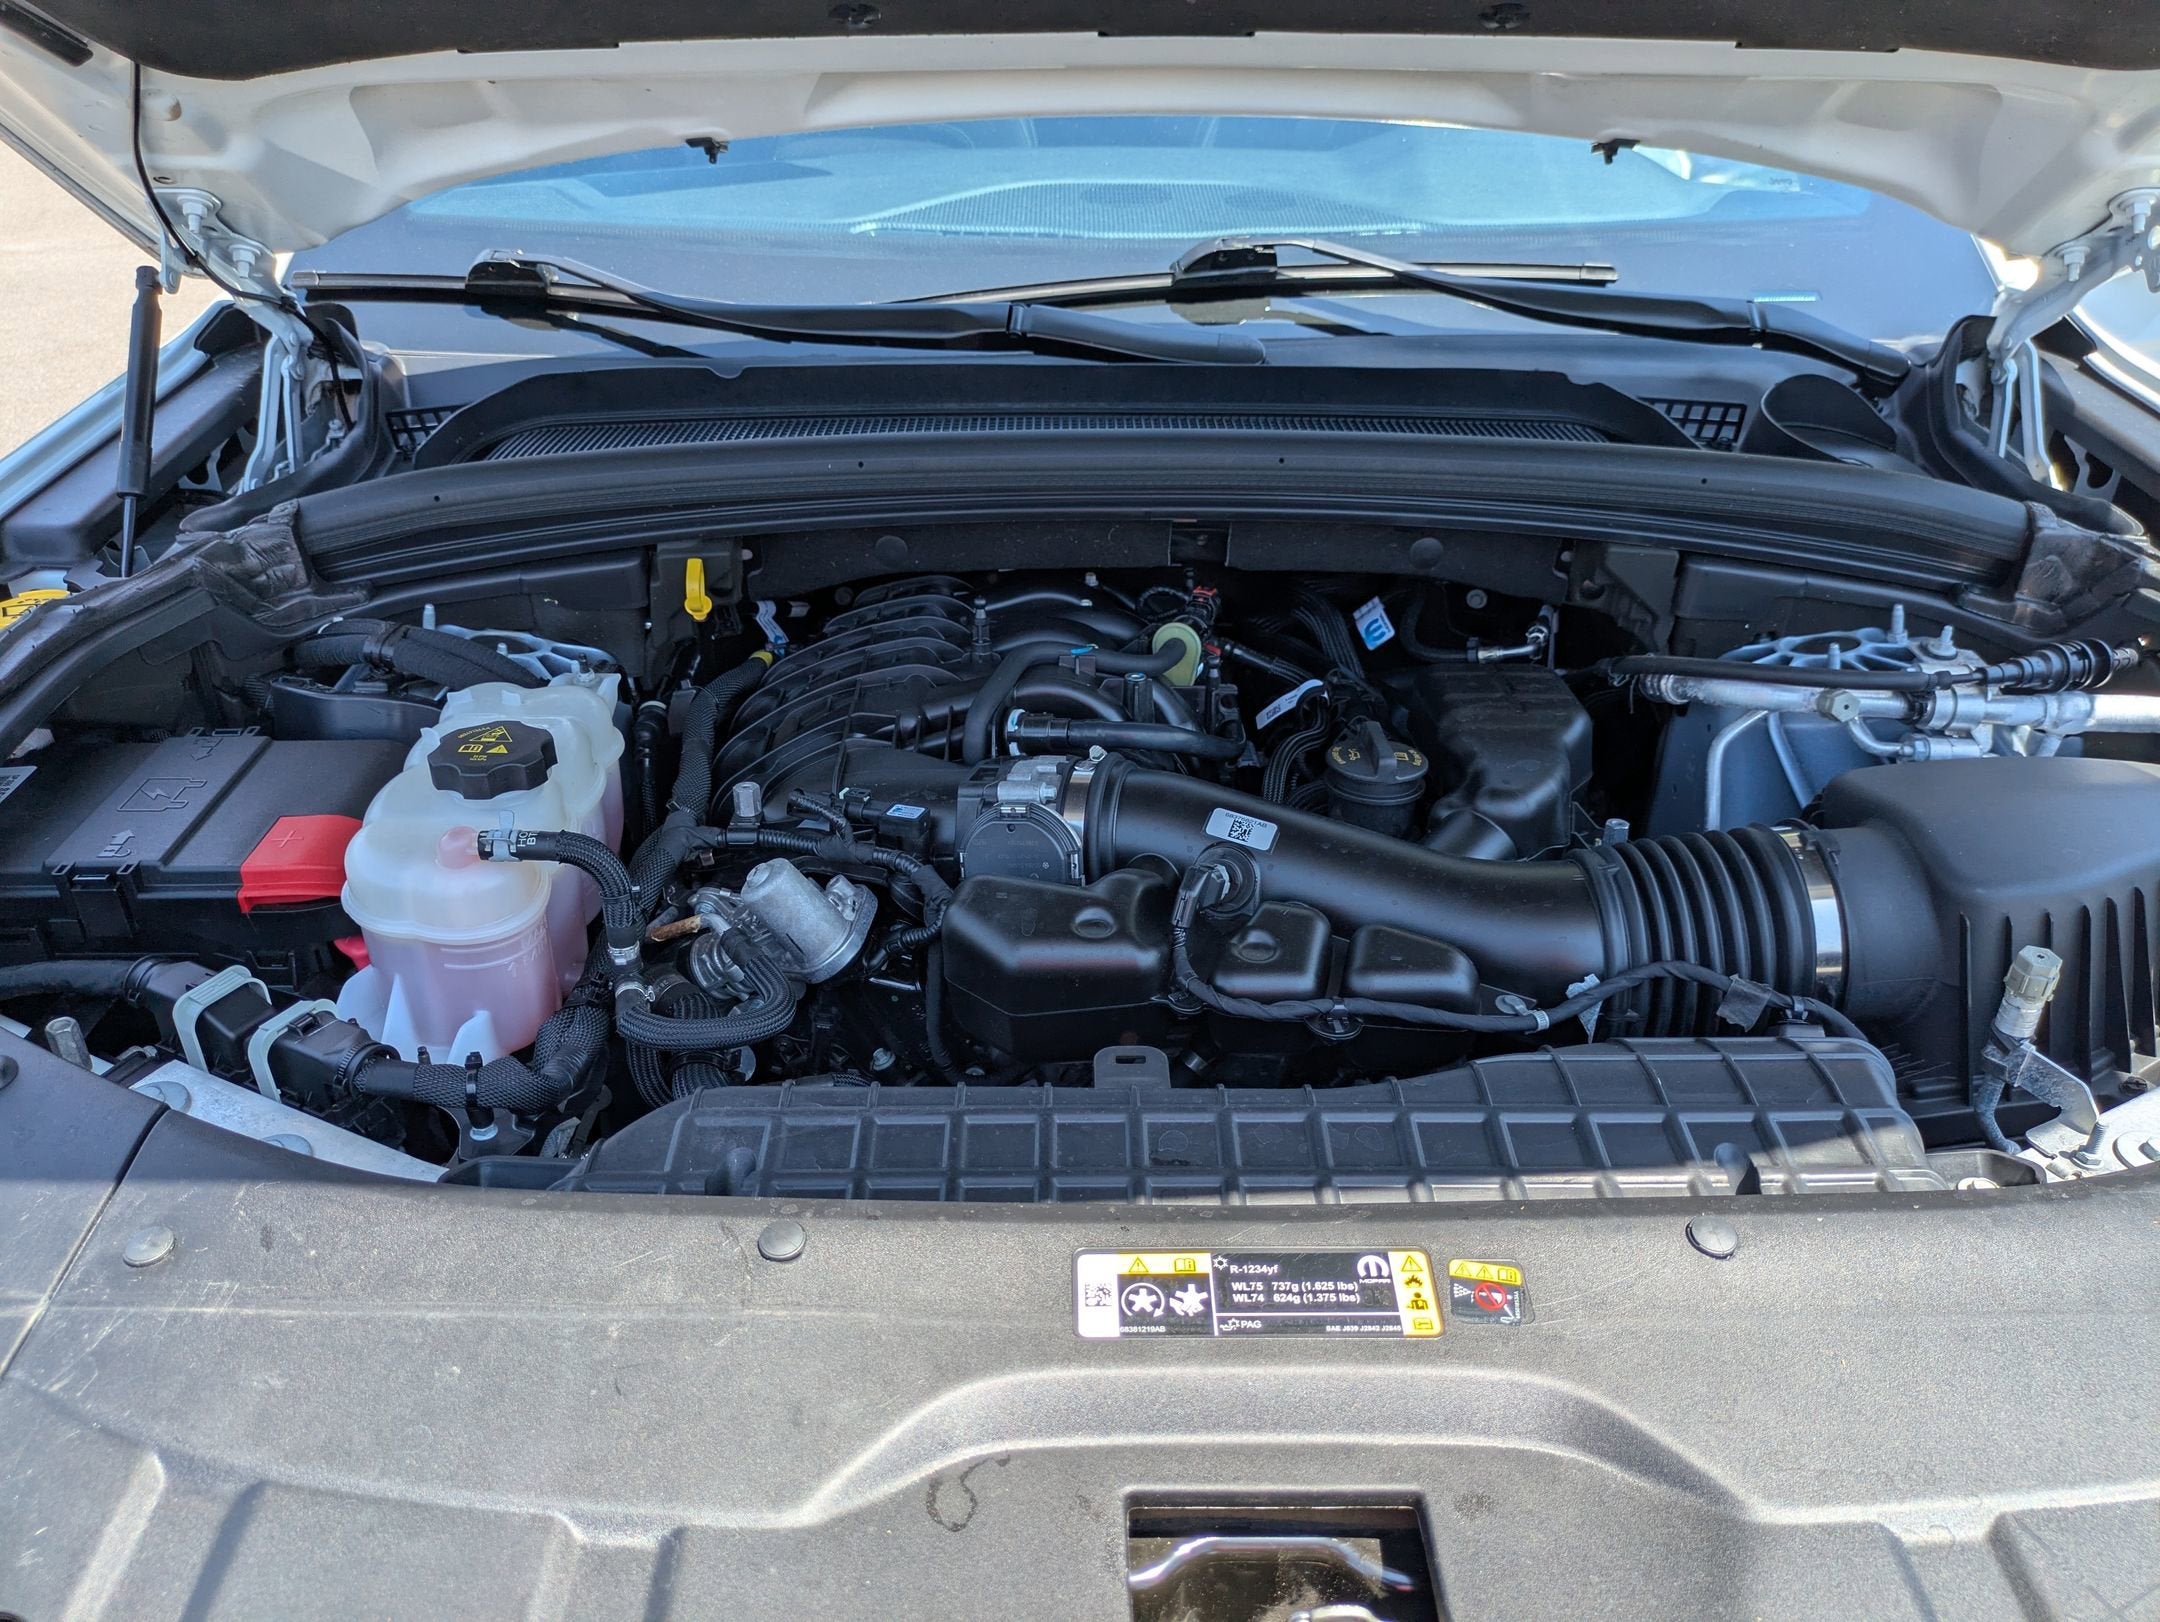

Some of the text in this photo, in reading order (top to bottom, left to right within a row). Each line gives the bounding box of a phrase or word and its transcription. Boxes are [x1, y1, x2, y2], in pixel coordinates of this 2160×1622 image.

[1230, 1264, 1279, 1276] R-1234yf
[1231, 1281, 1359, 1293] WL75 737g (1.625 lbs)
[1232, 1293, 1361, 1304] WL74 624g (1.375 lbs)
[1241, 1320, 1262, 1328] PAG
